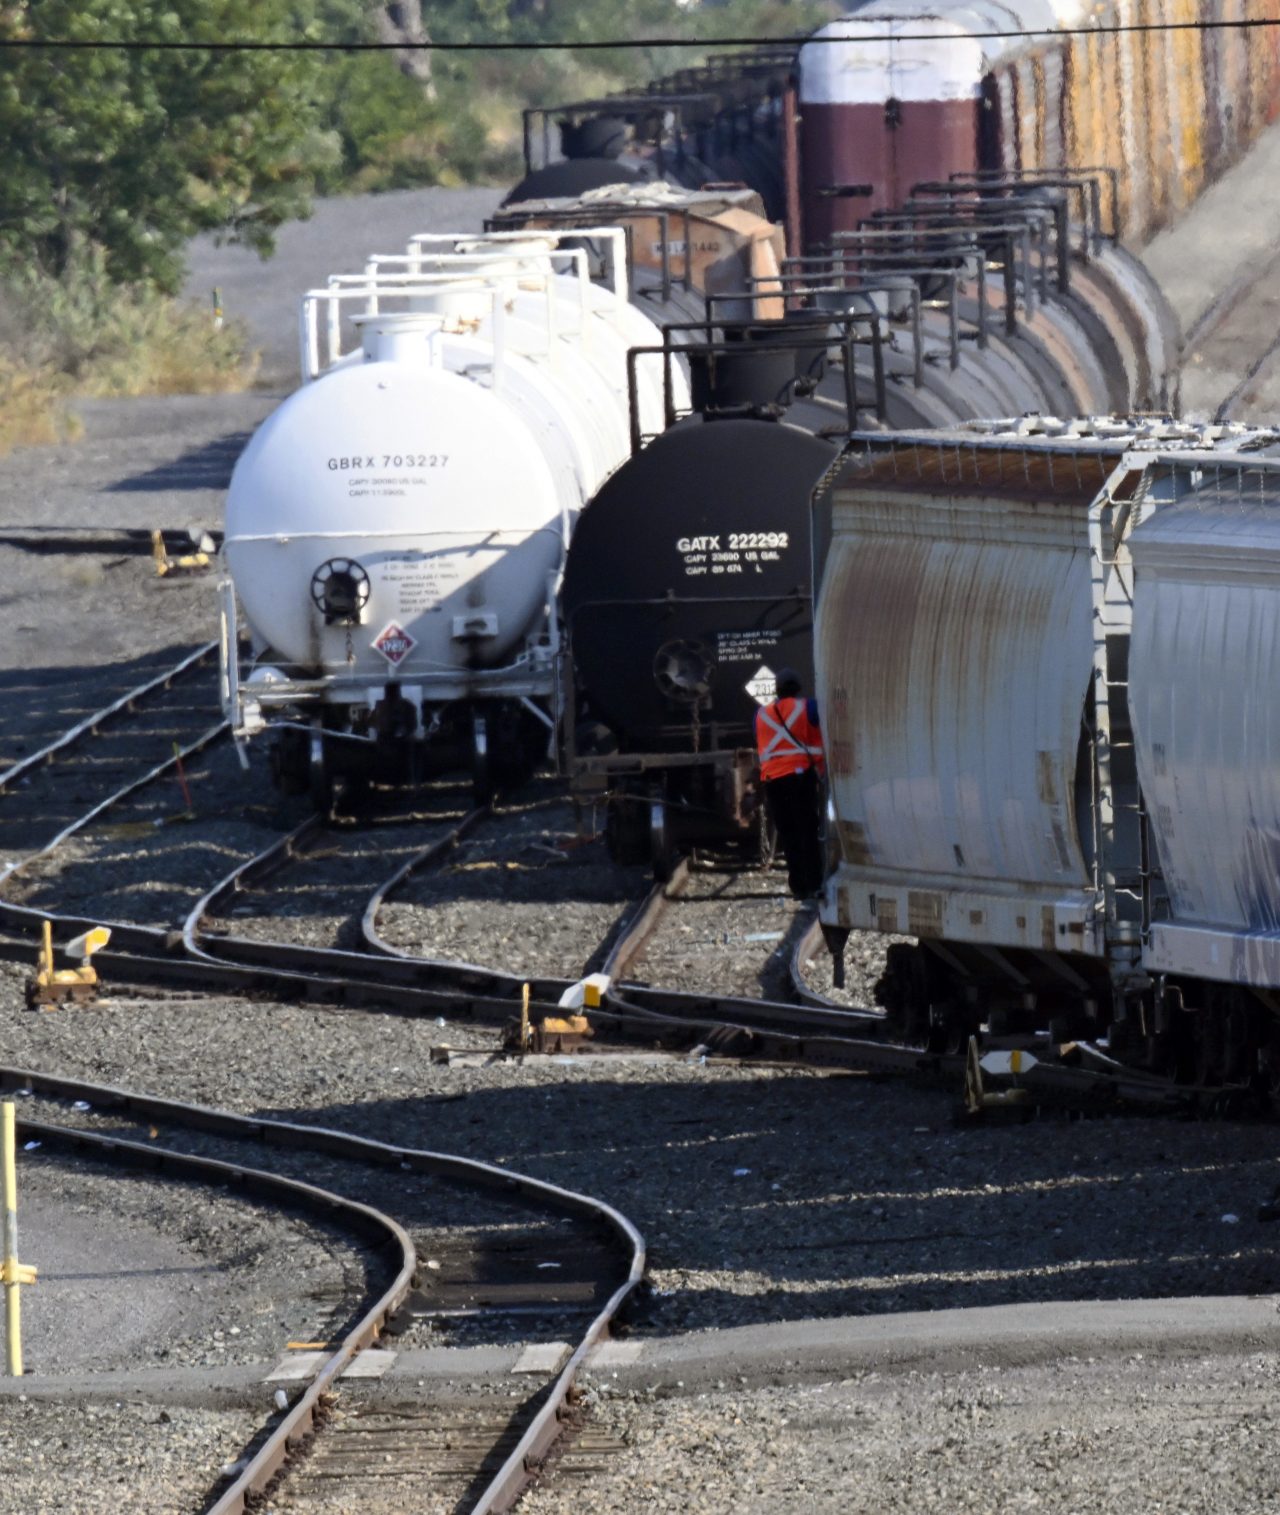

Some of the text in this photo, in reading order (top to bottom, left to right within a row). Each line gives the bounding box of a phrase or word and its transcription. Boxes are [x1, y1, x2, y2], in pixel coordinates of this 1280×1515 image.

[328, 454, 449, 471] GBRX 703227
[677, 531, 789, 553] GATX 222292
